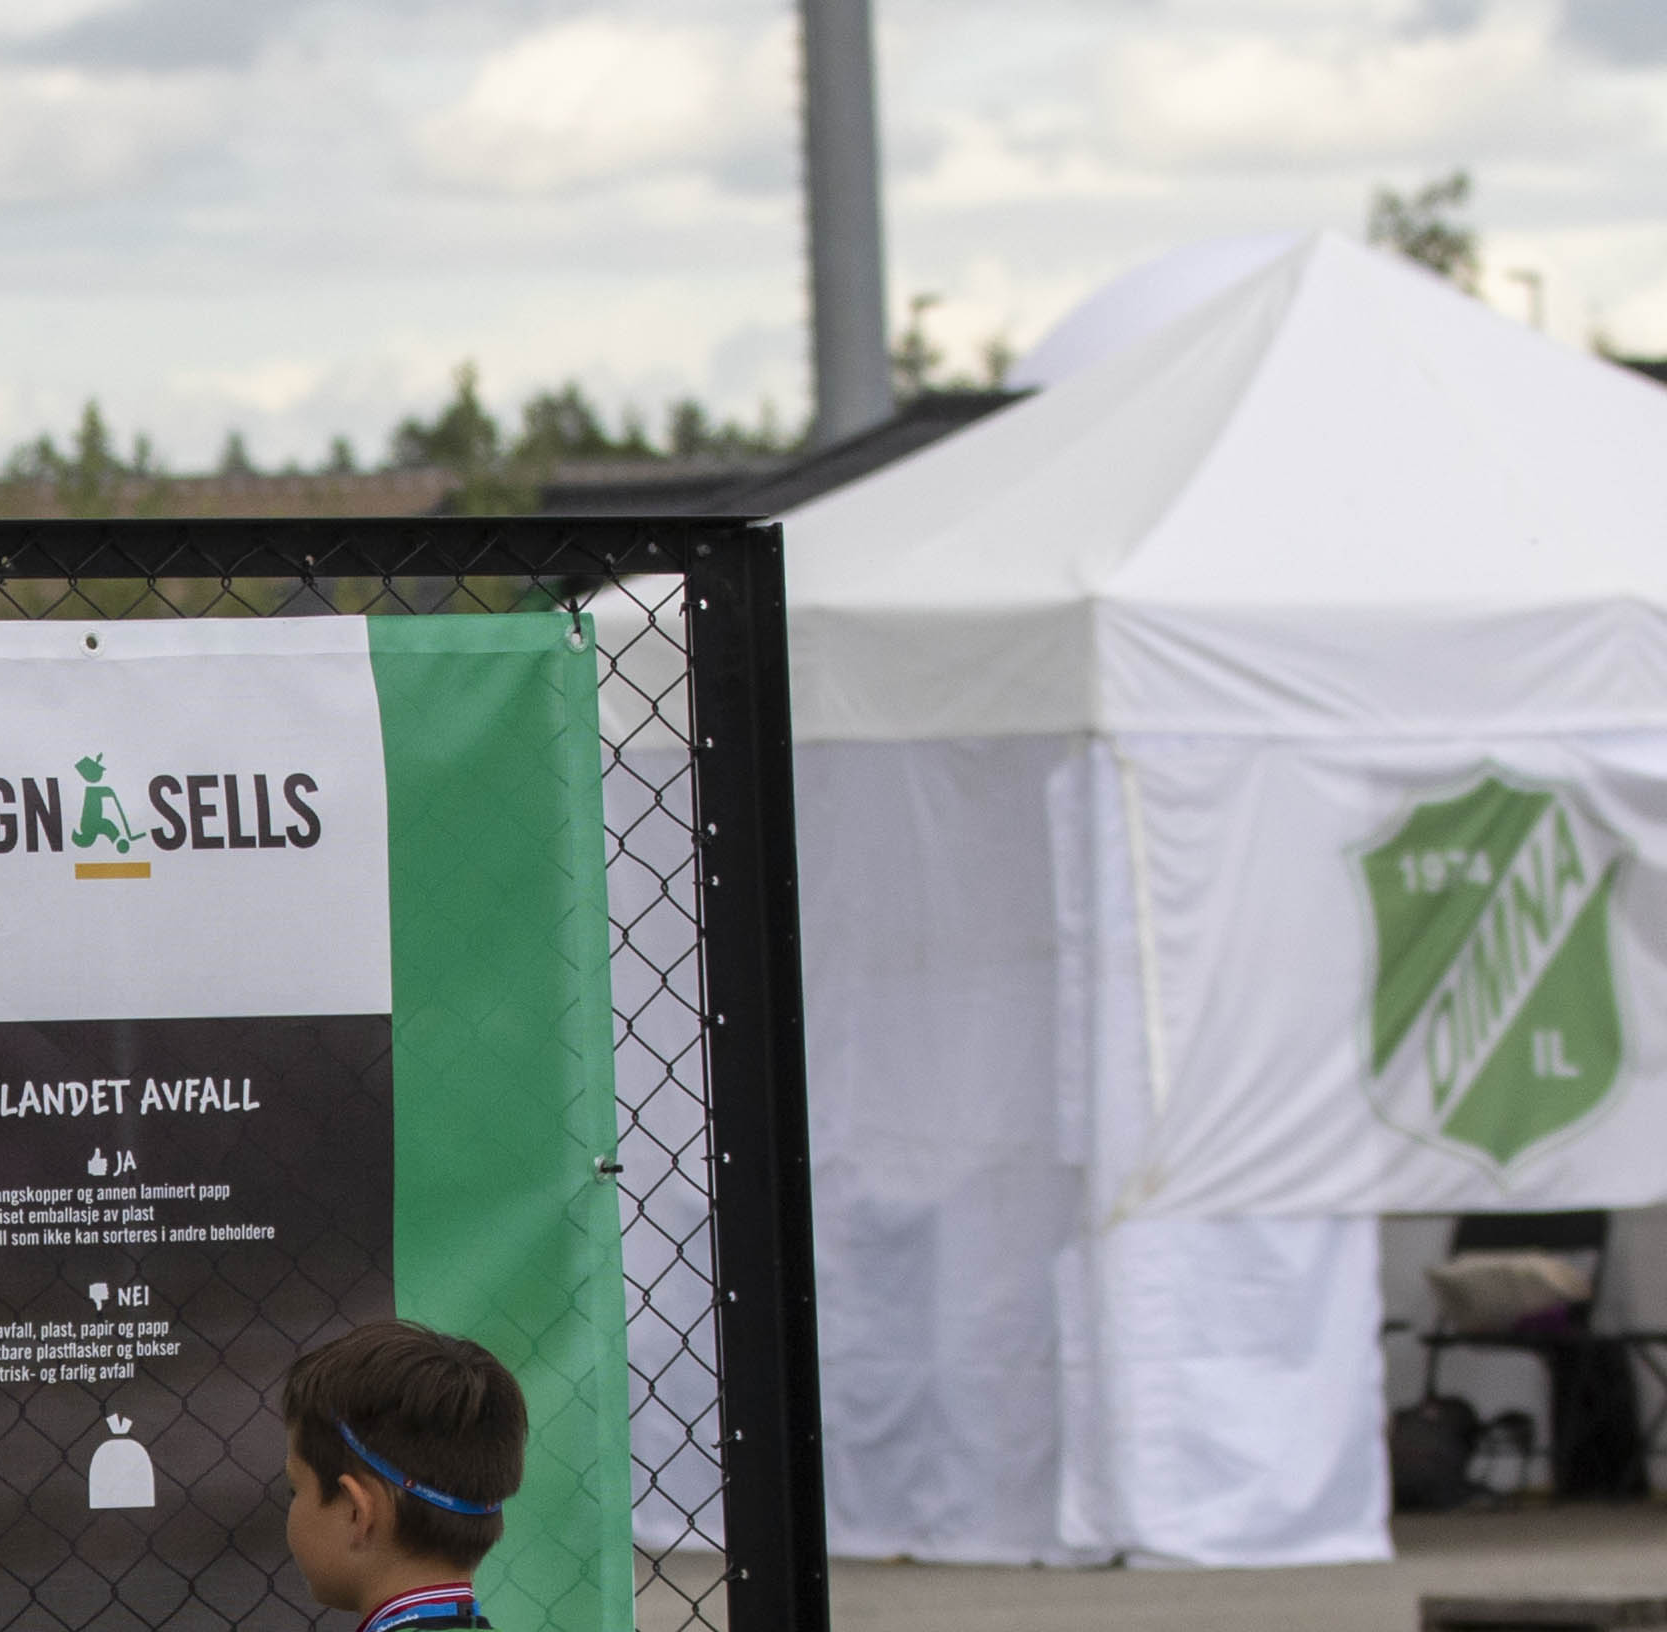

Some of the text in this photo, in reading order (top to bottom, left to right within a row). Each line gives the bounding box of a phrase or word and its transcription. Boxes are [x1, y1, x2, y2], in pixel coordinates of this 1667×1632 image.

[148, 773, 321, 851] SELLS
[140, 1077, 260, 1115] AVFALL
[113, 1150, 137, 1177] JA
[77, 1188, 93, 1204] og
[97, 1187, 137, 1201] annen
[141, 1184, 195, 1200] laminert
[199, 1185, 230, 1201] papp
[29, 1207, 99, 1226] emballasje
[104, 1210, 118, 1222] av
[122, 1206, 154, 1224] plast
[11, 1233, 39, 1246] som
[43, 1229, 70, 1245] ikke
[75, 1228, 99, 1244] kan
[103, 1228, 157, 1244] sorteres
[161, 1227, 166, 1243] i
[169, 1226, 206, 1242] andre
[210, 1225, 275, 1241] beholdere
[118, 1286, 149, 1307] NEI
[41, 1322, 76, 1340] plast,
[80, 1320, 114, 1339] papir
[118, 1323, 134, 1338] og
[138, 1321, 169, 1337] papp
[37, 1342, 112, 1362] plastflasker
[117, 1345, 133, 1359] og
[137, 1341, 181, 1356] bokser
[40, 1369, 56, 1383] og
[60, 1364, 96, 1383] farlig
[100, 1363, 134, 1379] avfall
